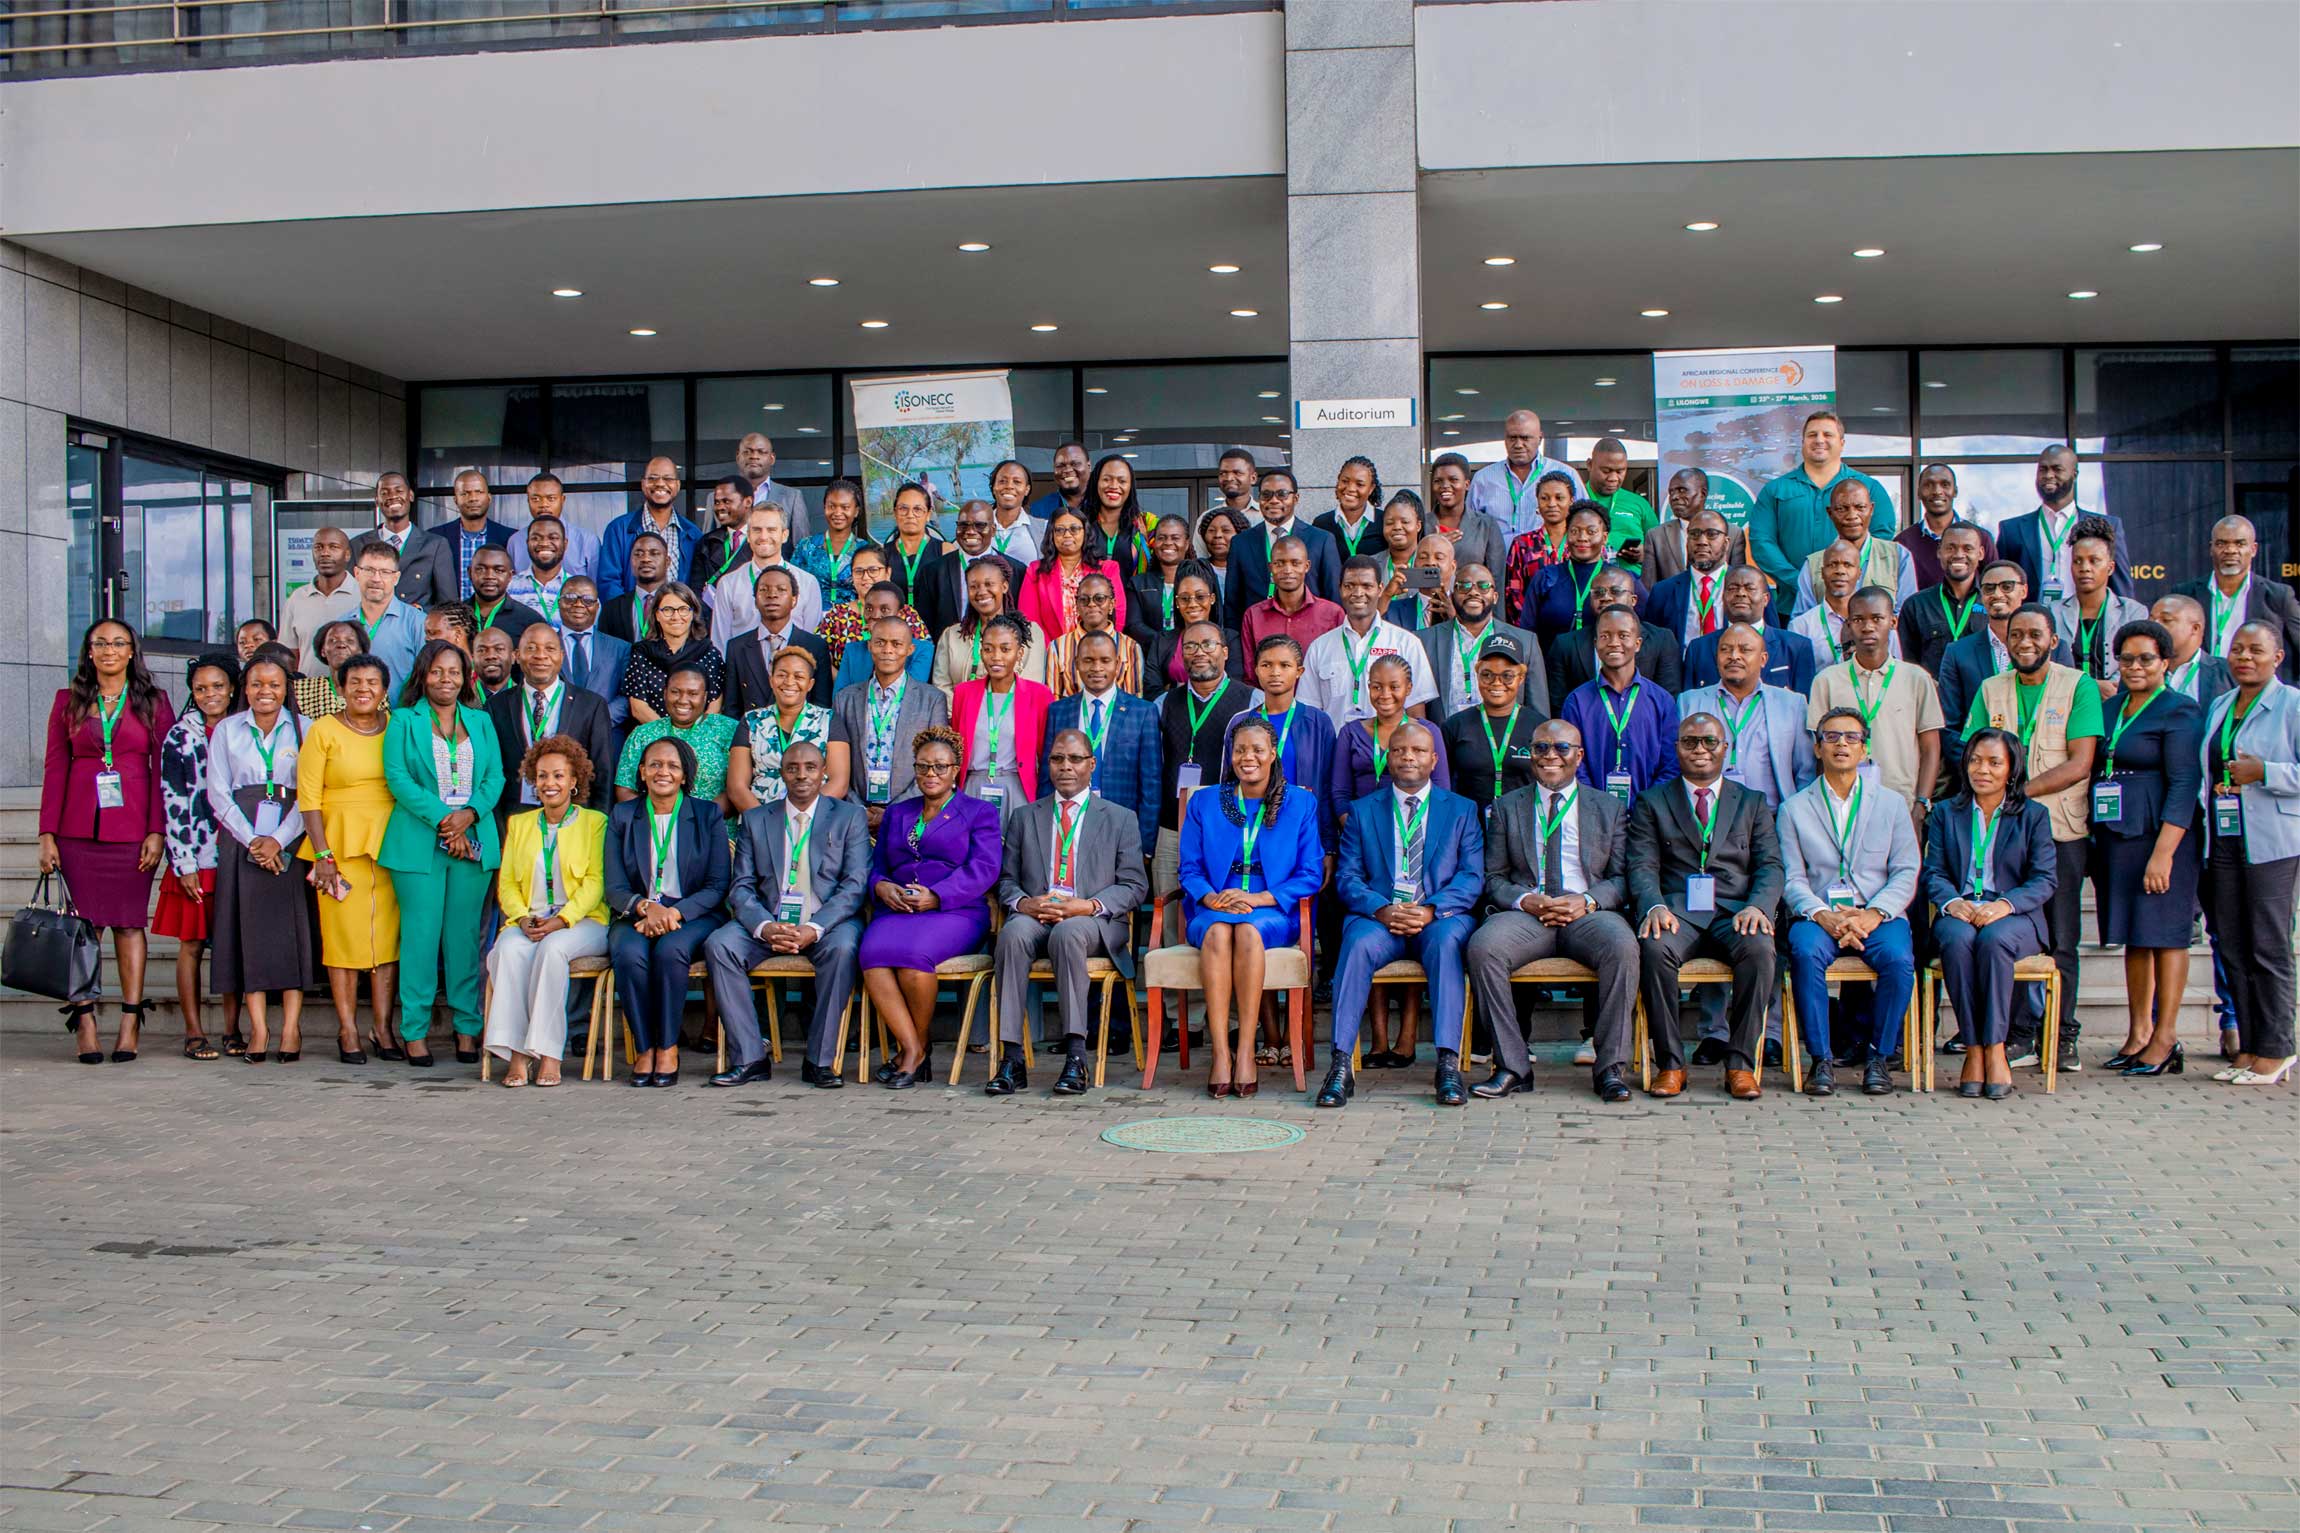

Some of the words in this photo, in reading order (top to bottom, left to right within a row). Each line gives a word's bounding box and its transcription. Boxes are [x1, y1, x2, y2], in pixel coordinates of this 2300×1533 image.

[1680, 379, 1696, 389] ON
[1699, 378, 1721, 388] LOSS
[1733, 375, 1780, 386] DAMAGE
[900, 393, 954, 408] ISONECC
[1676, 398, 1709, 406] LILONGWE
[1317, 407, 1395, 421] Auditorium
[2281, 563, 2300, 577] BI
